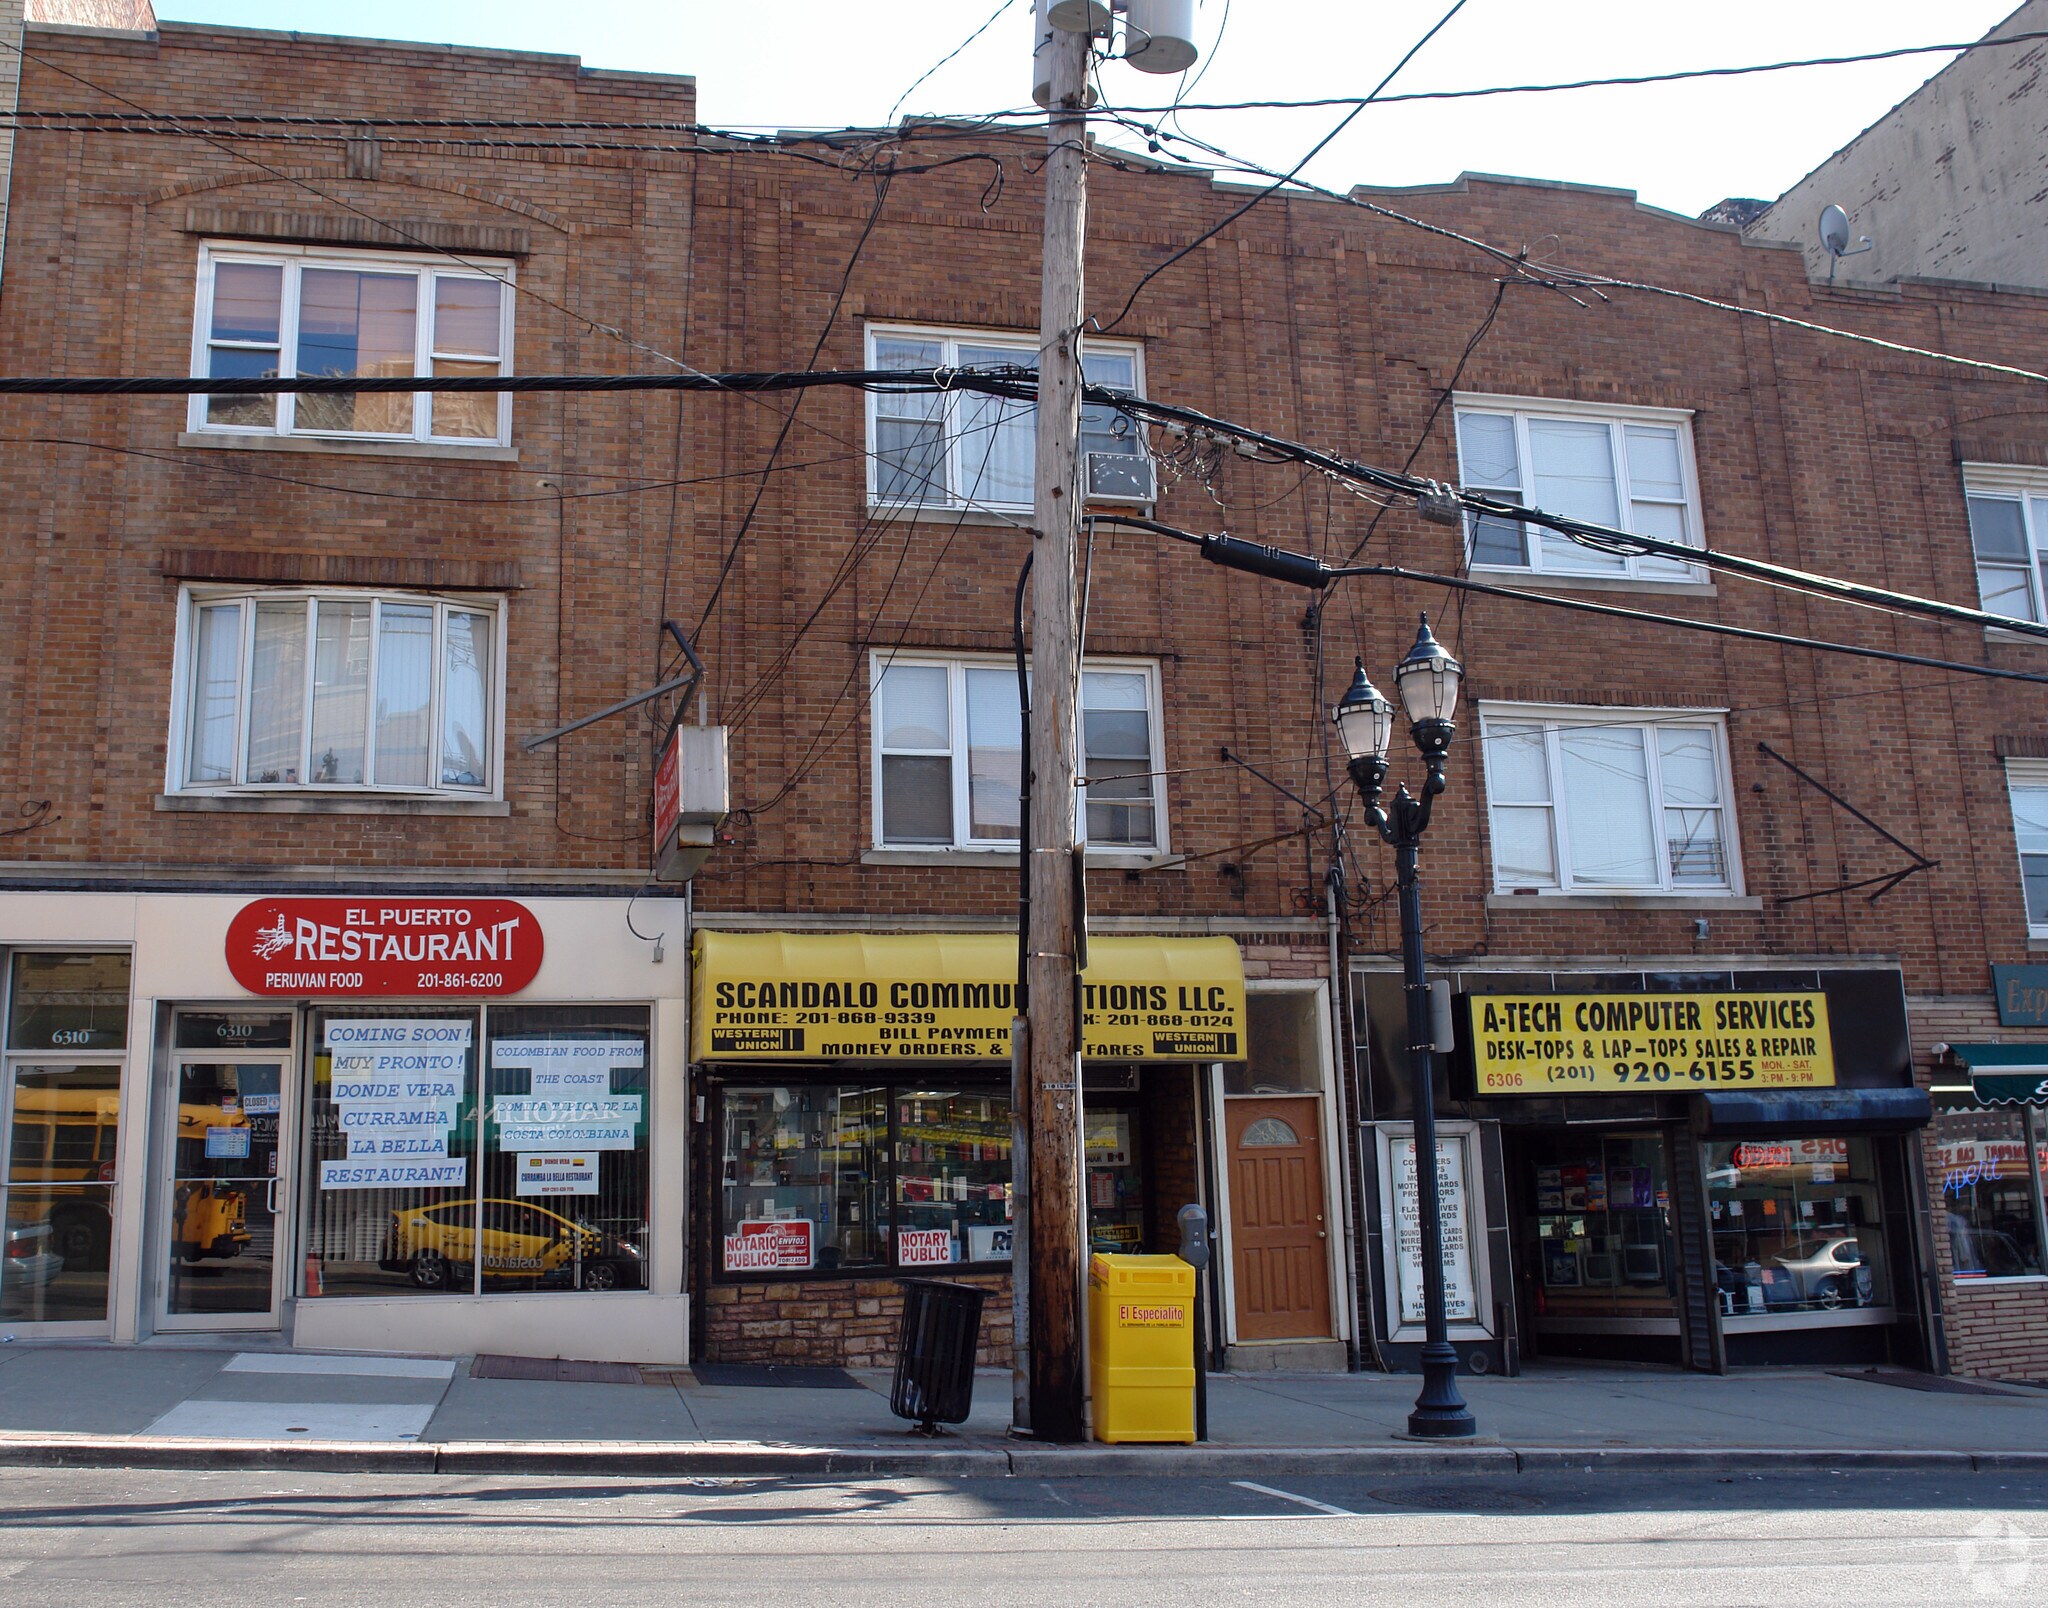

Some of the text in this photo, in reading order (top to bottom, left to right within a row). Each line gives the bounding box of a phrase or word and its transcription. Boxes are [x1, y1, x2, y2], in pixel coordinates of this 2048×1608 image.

[345, 908, 471, 926] EL PUERTO
[294, 916, 519, 962] RESTAURANT
[265, 972, 503, 988] PERUVIAN FOOD 201-861-6200
[716, 981, 1235, 1012] SCANDALO COMMUTIONS LLC.
[716, 1012, 788, 1024] PHONE:
[796, 1012, 936, 1024] 201-868-9339
[1107, 1015, 1233, 1027] 201-868-0124
[1483, 999, 1816, 1034] A-TECH COMPUTER SERVICES
[52, 1028, 90, 1045] 6310
[216, 1023, 253, 1040] 6310
[329, 1027, 471, 1042] COMING SOON!
[713, 1029, 780, 1039] WESTERN
[879, 1027, 921, 1040] BILL
[1153, 1032, 1215, 1042] WESTERN
[496, 1047, 643, 1057] COLOMBIAN FOOD FROM
[735, 1041, 780, 1050] UNION
[821, 1043, 892, 1055] MONEY
[989, 1044, 1003, 1056] &
[1087, 1044, 1145, 1056] FARES
[1174, 1044, 1215, 1053] UNION
[1486, 1040, 1574, 1060] DESK-TOPS
[1582, 1041, 1595, 1059] &
[1696, 1038, 1741, 1059] SALES
[1745, 1039, 1757, 1057] &
[1761, 1036, 1817, 1057] REPAIR
[334, 1054, 463, 1070] MUY PRONTO!
[1761, 1060, 1785, 1070] MON.
[1792, 1059, 1812, 1070] SAT.
[535, 1074, 604, 1084] THE COAST
[1486, 1060, 1755, 1087] 6306 (201) 920-6155
[1770, 1073, 1783, 1083] PM
[1800, 1072, 1814, 1082] PM
[336, 1083, 456, 1098] DONDE VERA
[244, 1096, 267, 1108] CLOSED
[498, 1101, 639, 1112] COMIDA TIPICA DE LA
[343, 1111, 449, 1126] CURRAMBA
[504, 1129, 630, 1140] COSTA COLOMBIANA
[351, 1139, 444, 1154] LA BELLA
[324, 1165, 464, 1184] RESTAURANT!
[1400, 1227, 1463, 1237] SOUND CARDS
[1443, 1235, 1463, 1243] LANS
[726, 1235, 777, 1252] NOTARIO
[778, 1236, 805, 1245] ENVIOS
[901, 1232, 948, 1248] NOTARY
[726, 1251, 777, 1268] PUBLICO
[901, 1246, 949, 1263] PUBLIC
[1120, 1305, 1183, 1323] El Especialito
